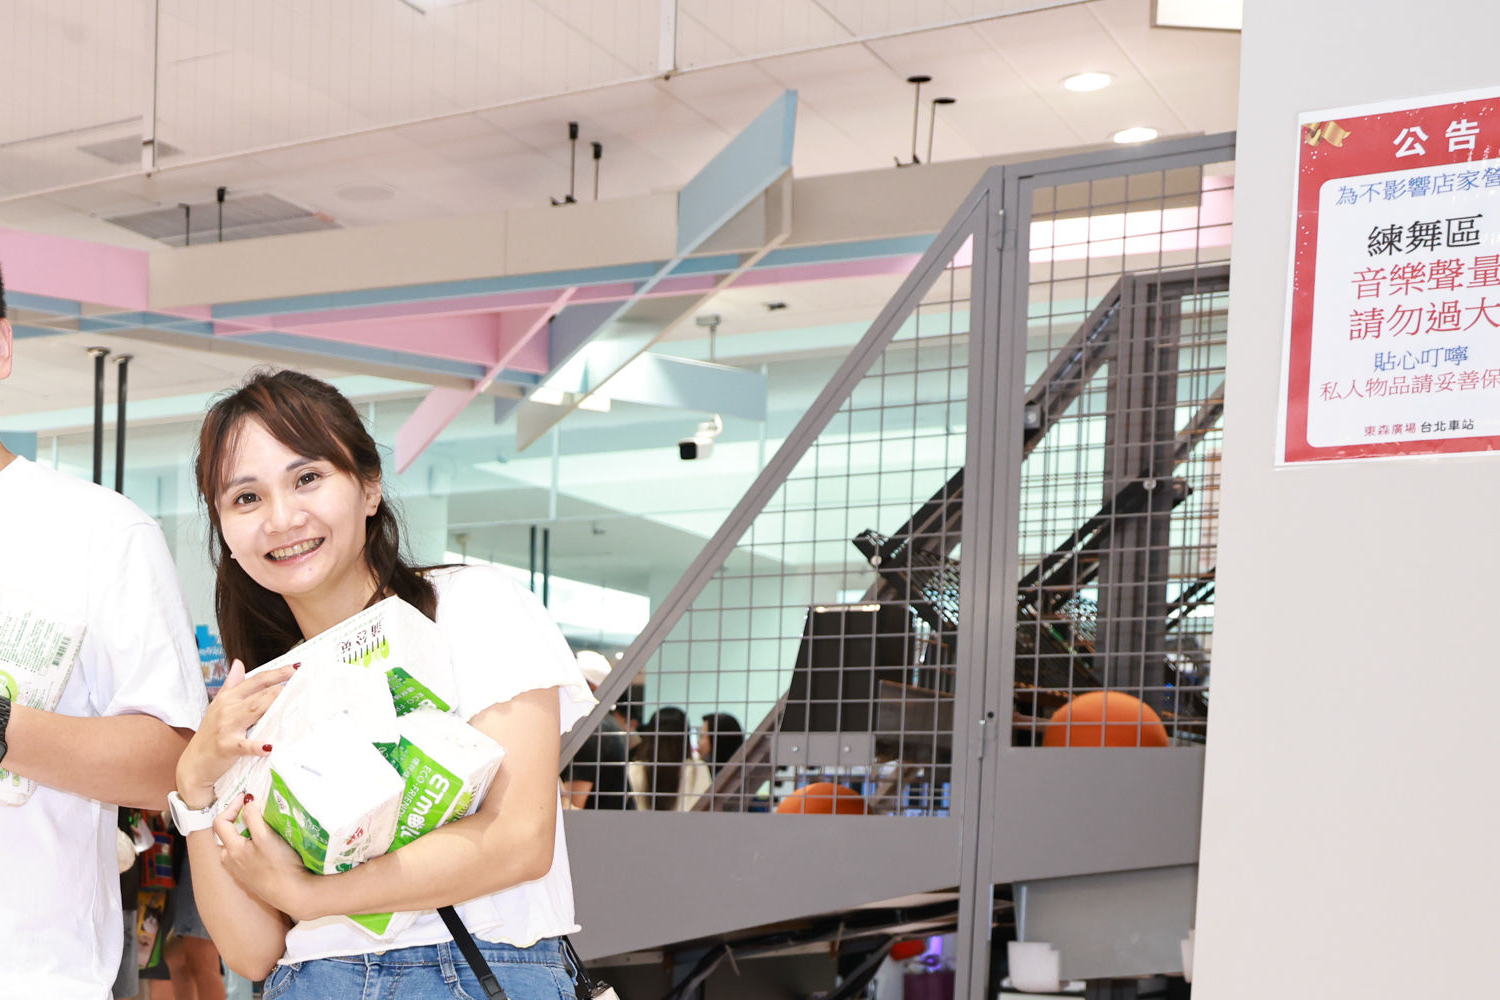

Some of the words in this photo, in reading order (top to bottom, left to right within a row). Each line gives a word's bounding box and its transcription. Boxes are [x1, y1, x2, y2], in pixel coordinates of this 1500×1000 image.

[1393, 119, 1479, 159] 公告
[1367, 213, 1483, 257] 練舞區
[1351, 254, 1500, 300] 音樂聲量
[1349, 297, 1500, 341] 請勿過大
[1373, 345, 1469, 373] 貼心叮嚀
[1320, 367, 1500, 402] 私人物品請妥善保
[1420, 418, 1474, 434] 台北車站
